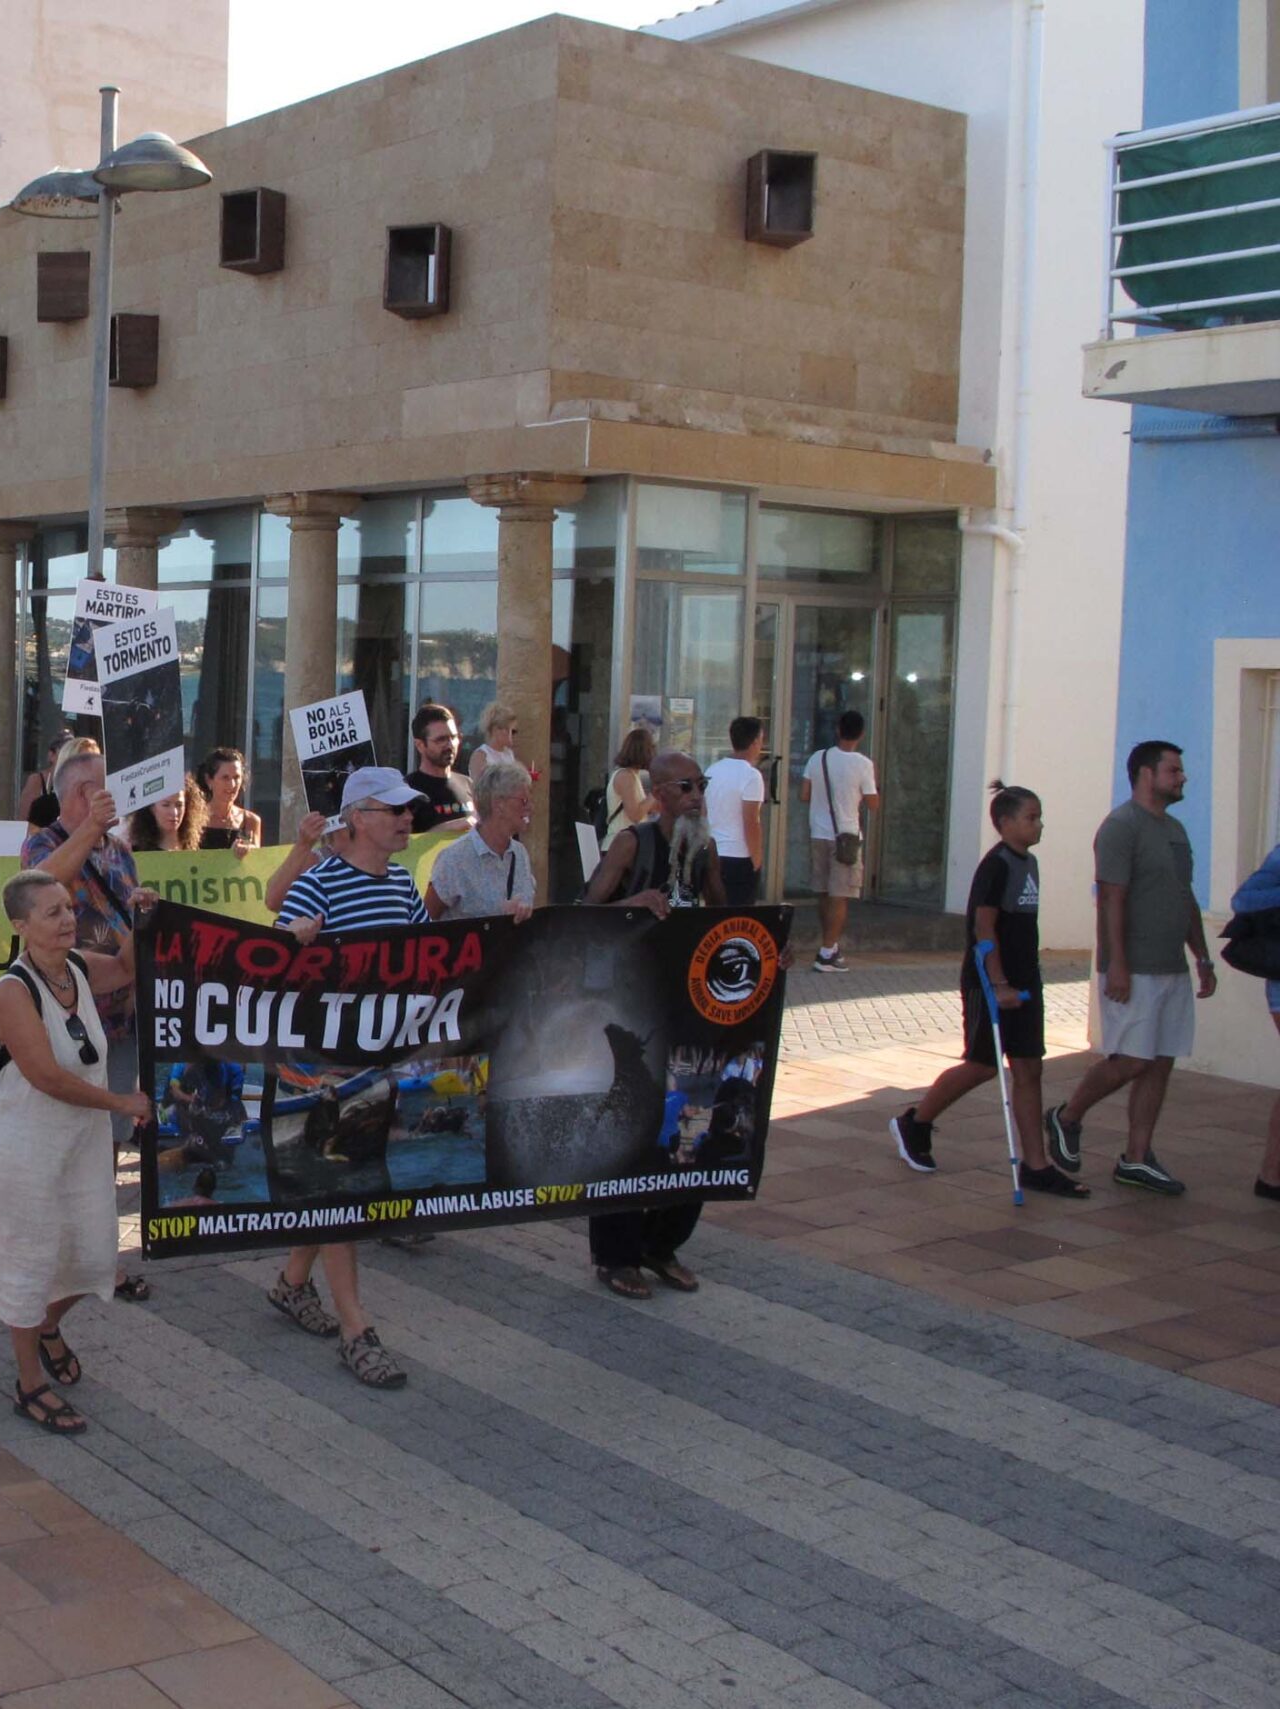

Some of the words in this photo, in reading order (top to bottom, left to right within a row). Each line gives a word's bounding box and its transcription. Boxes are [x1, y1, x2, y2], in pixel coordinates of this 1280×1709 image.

[96, 588, 123, 603] ESTO
[125, 593, 139, 606] ES
[114, 627, 142, 649] ESTO
[143, 621, 158, 639] ES
[103, 635, 172, 675] TORMENTO
[306, 707, 326, 724] NO
[329, 701, 351, 719] ALS
[308, 720, 345, 740] BOUS
[347, 716, 355, 729] A
[311, 741, 327, 755] LA
[329, 729, 359, 750] MAR
[723, 919, 760, 935] ANIMAL
[154, 930, 183, 965] LA
[190, 920, 485, 988] TORTURA
[154, 978, 185, 1010] NO
[194, 981, 465, 1052] CULTURA
[154, 1017, 182, 1048] ES
[148, 1215, 198, 1241] STOP
[198, 1211, 297, 1236] MALTRATO
[297, 1204, 366, 1228] ANIMAL
[366, 1197, 413, 1222] STOP
[414, 1193, 480, 1218] ANIMAL
[481, 1188, 535, 1210] ABUSE
[535, 1182, 585, 1206] STOP
[586, 1168, 750, 1200] TIERMISSHANDLUNG
